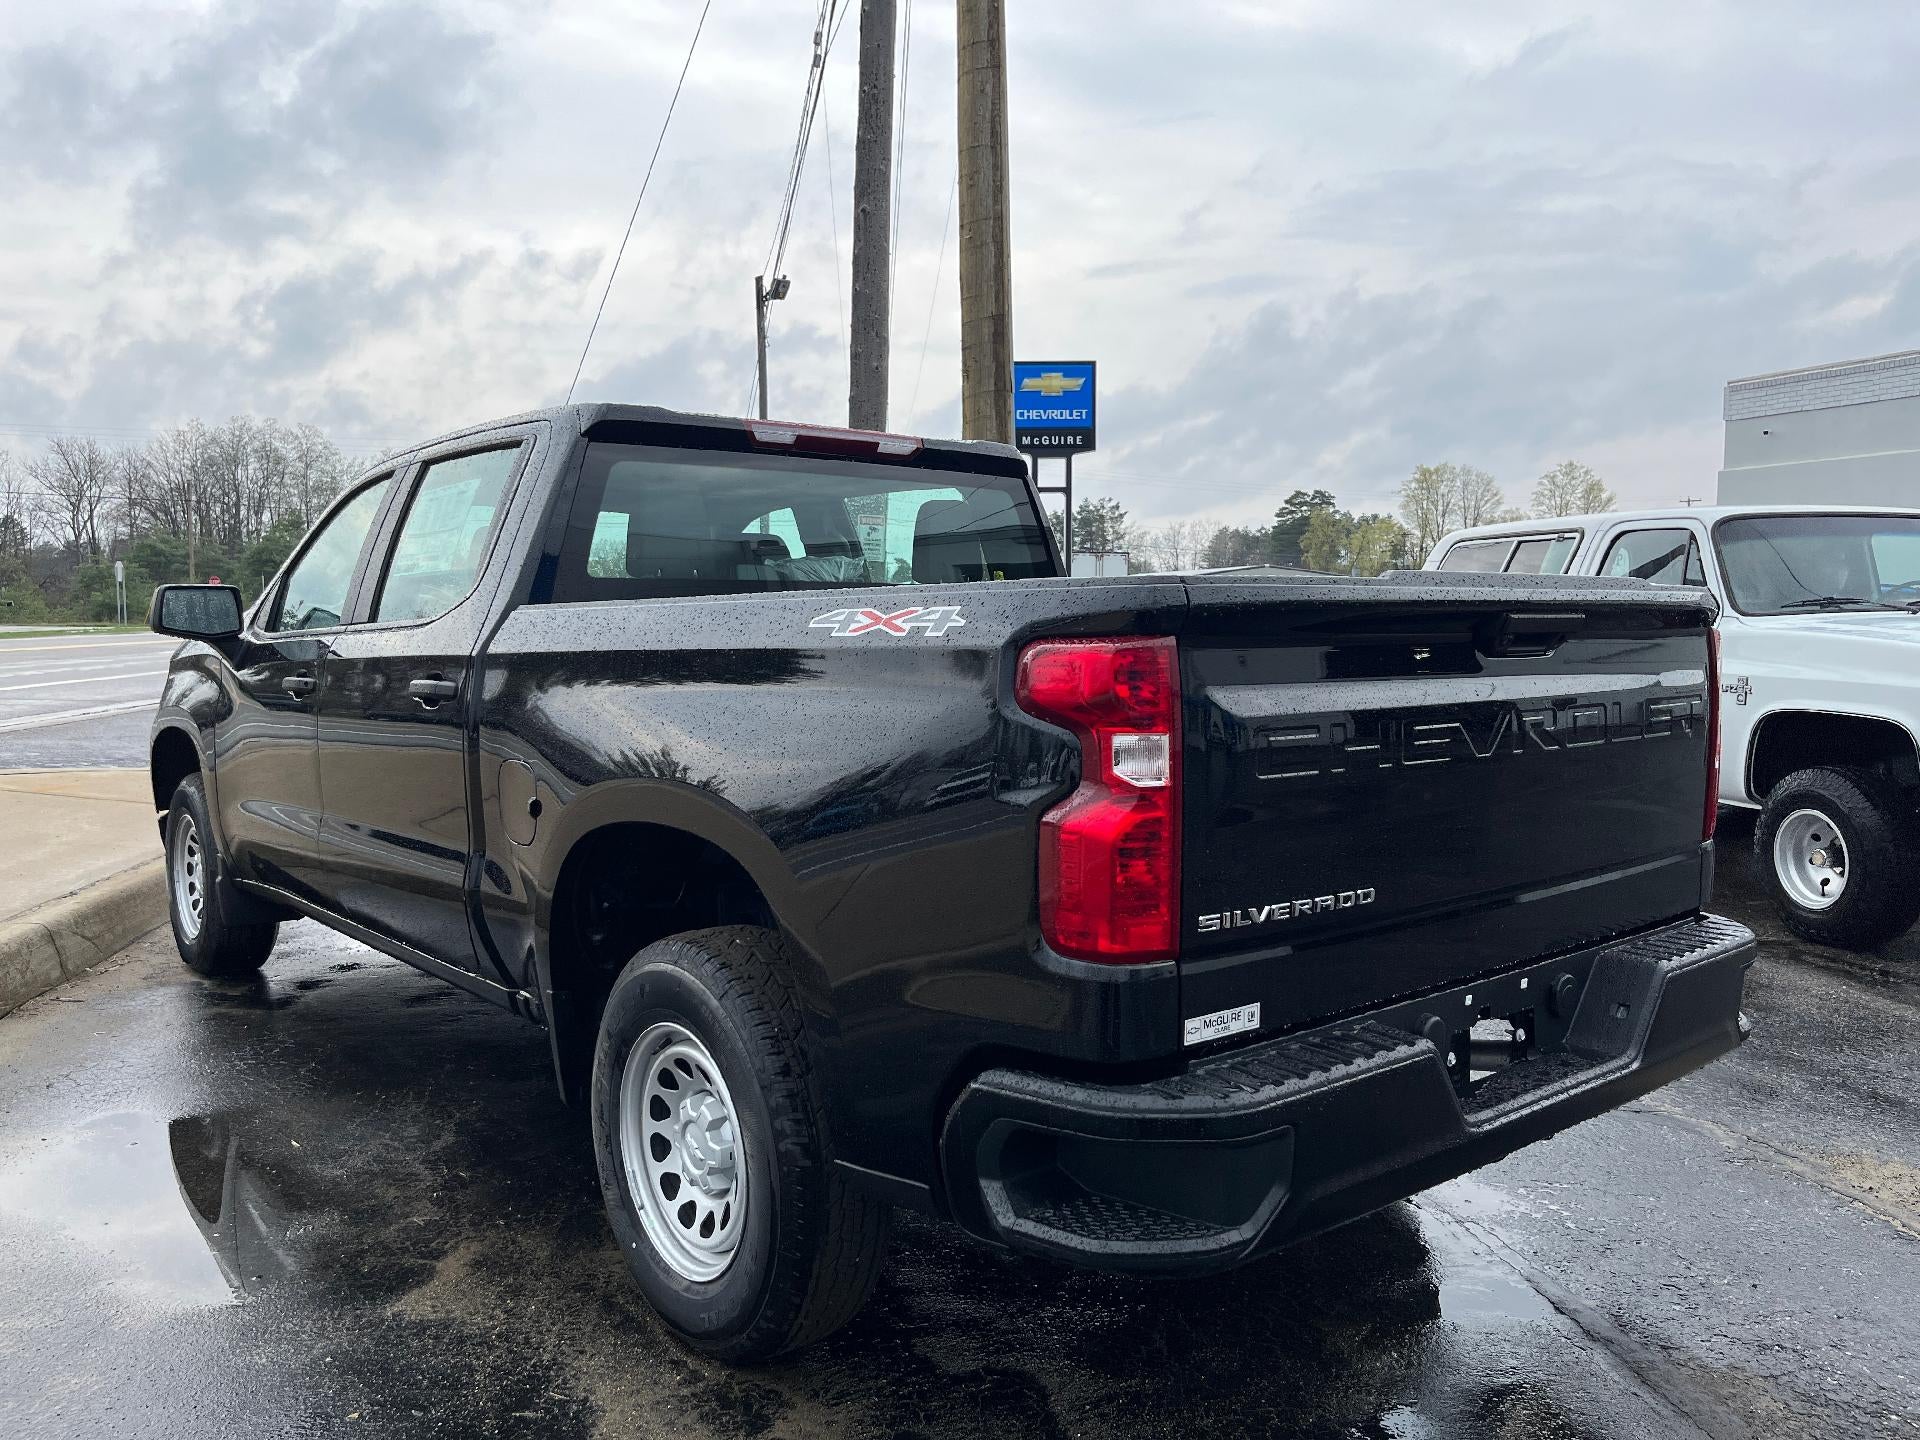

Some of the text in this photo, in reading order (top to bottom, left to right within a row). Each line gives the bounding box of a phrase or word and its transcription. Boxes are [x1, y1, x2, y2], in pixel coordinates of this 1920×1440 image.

[1016, 409, 1088, 420] CHEVROLET
[1021, 435, 1083, 445] McGUIRE
[1198, 888, 1375, 932] SILVERADO
[1203, 1010, 1242, 1030] McGUIRE
